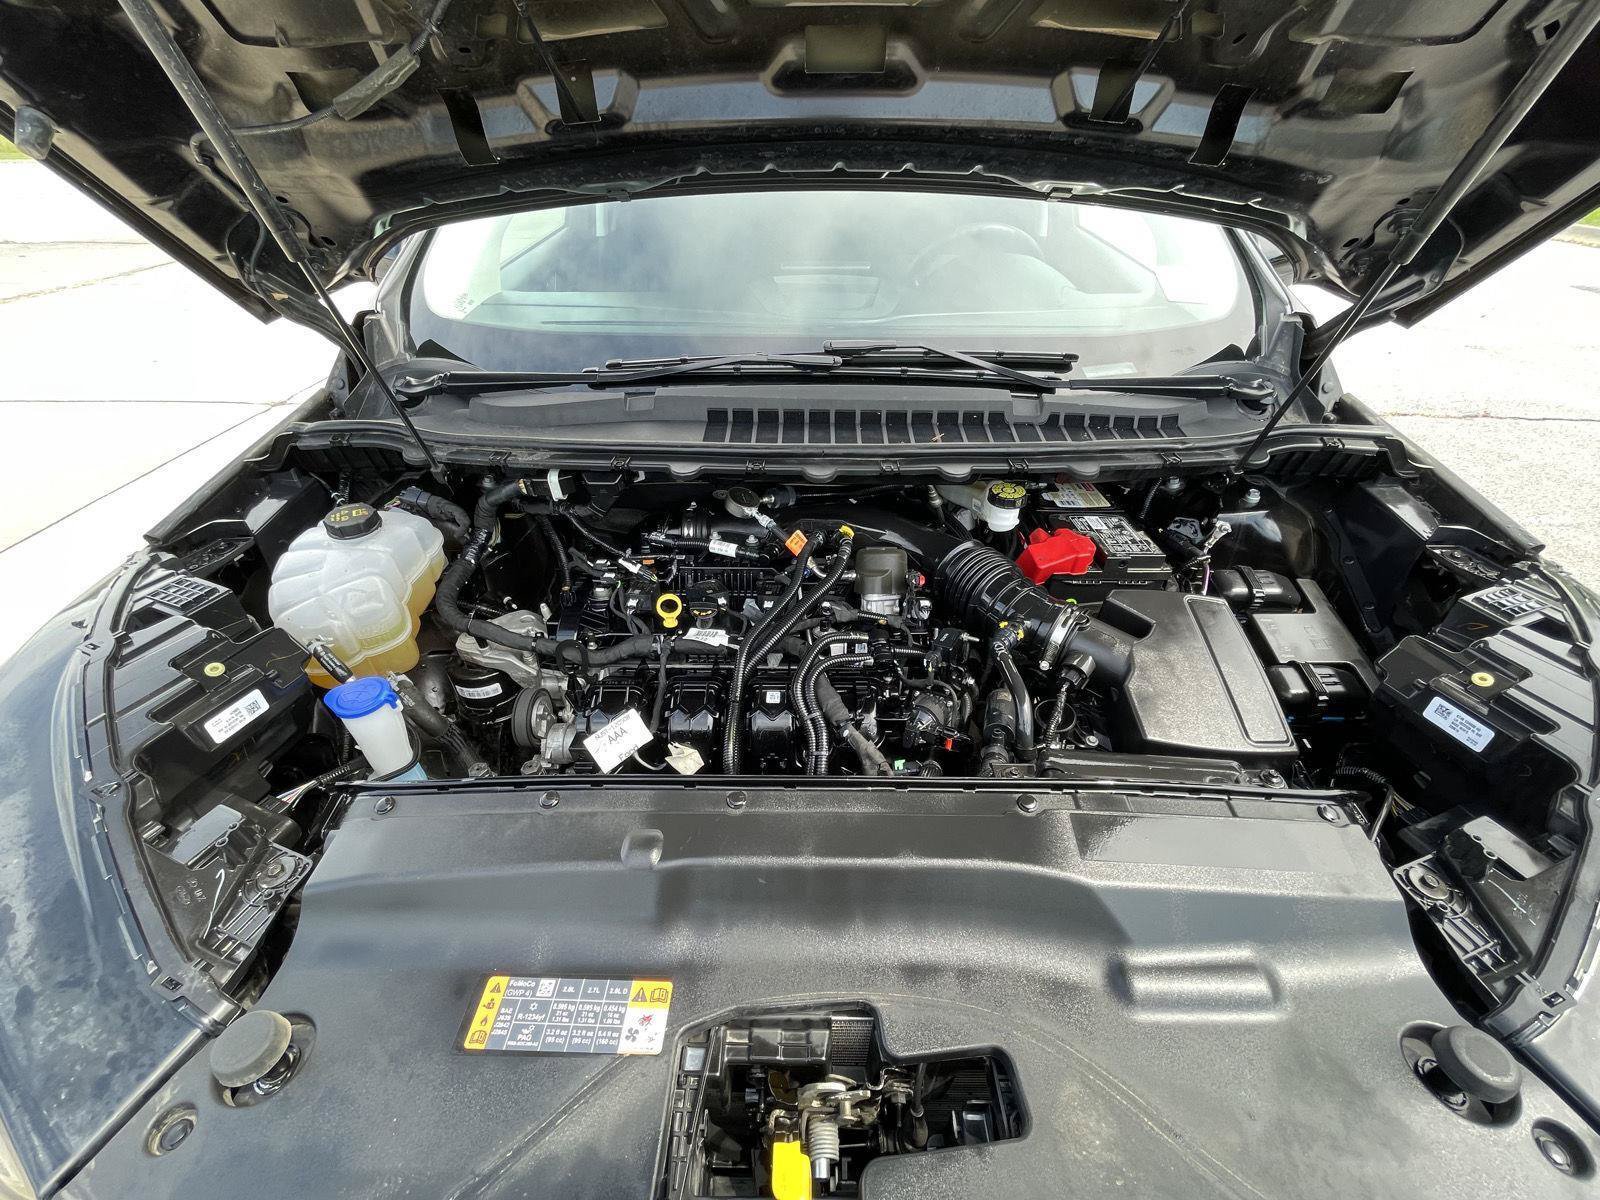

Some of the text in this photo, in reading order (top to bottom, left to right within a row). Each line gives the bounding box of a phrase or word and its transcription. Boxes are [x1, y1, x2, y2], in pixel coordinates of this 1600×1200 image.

[608, 727, 628, 745] AAA
[508, 979, 536, 987] FoMoCo
[504, 989, 524, 997] (GWP
